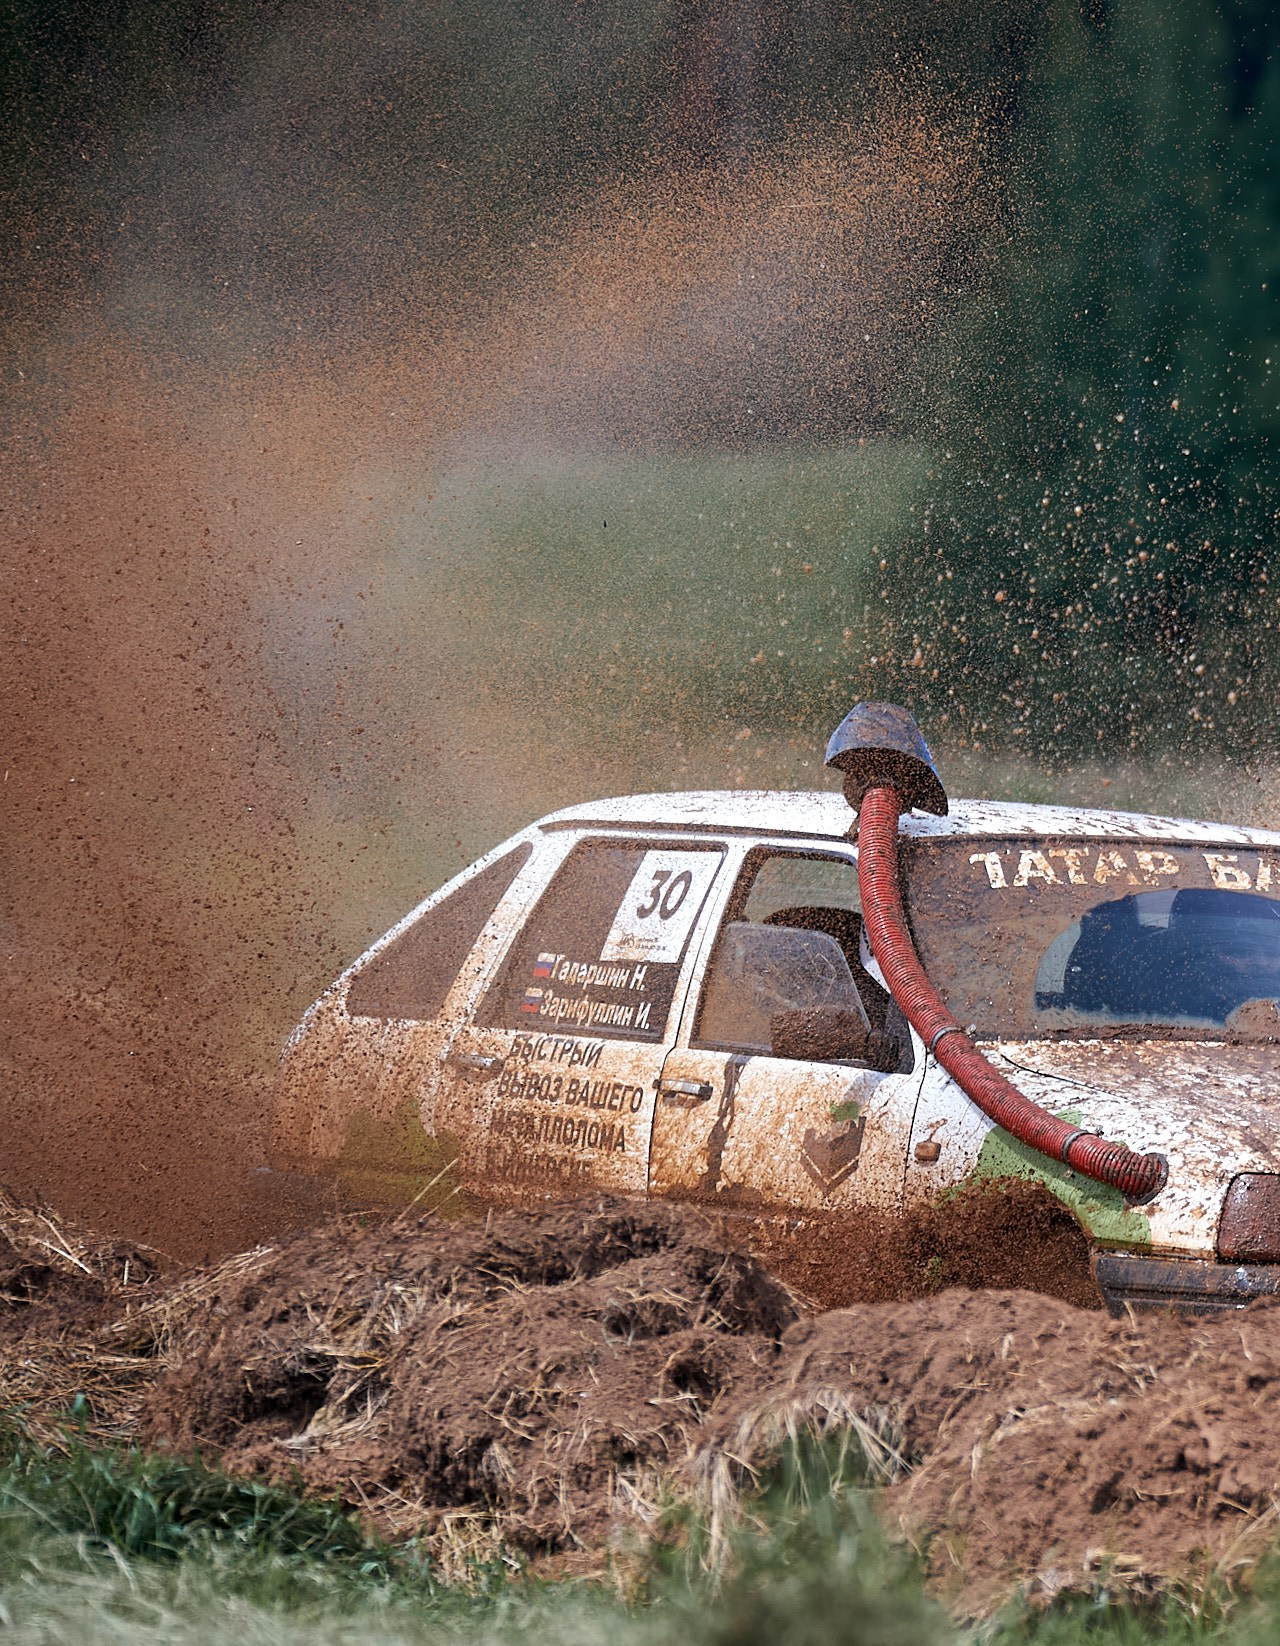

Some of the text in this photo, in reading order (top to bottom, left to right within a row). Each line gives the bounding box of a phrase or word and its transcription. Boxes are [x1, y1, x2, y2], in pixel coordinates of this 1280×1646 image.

[968, 847, 1180, 889] ТАТАР
[636, 870, 693, 921] 30
[550, 954, 648, 991] Гадаршин Н.
[540, 989, 652, 1030] Зарифуллин И.
[510, 1033, 606, 1068] БЫСТРЫЙ
[498, 1070, 644, 1113] ВЫВОЗ ВАШЕГО
